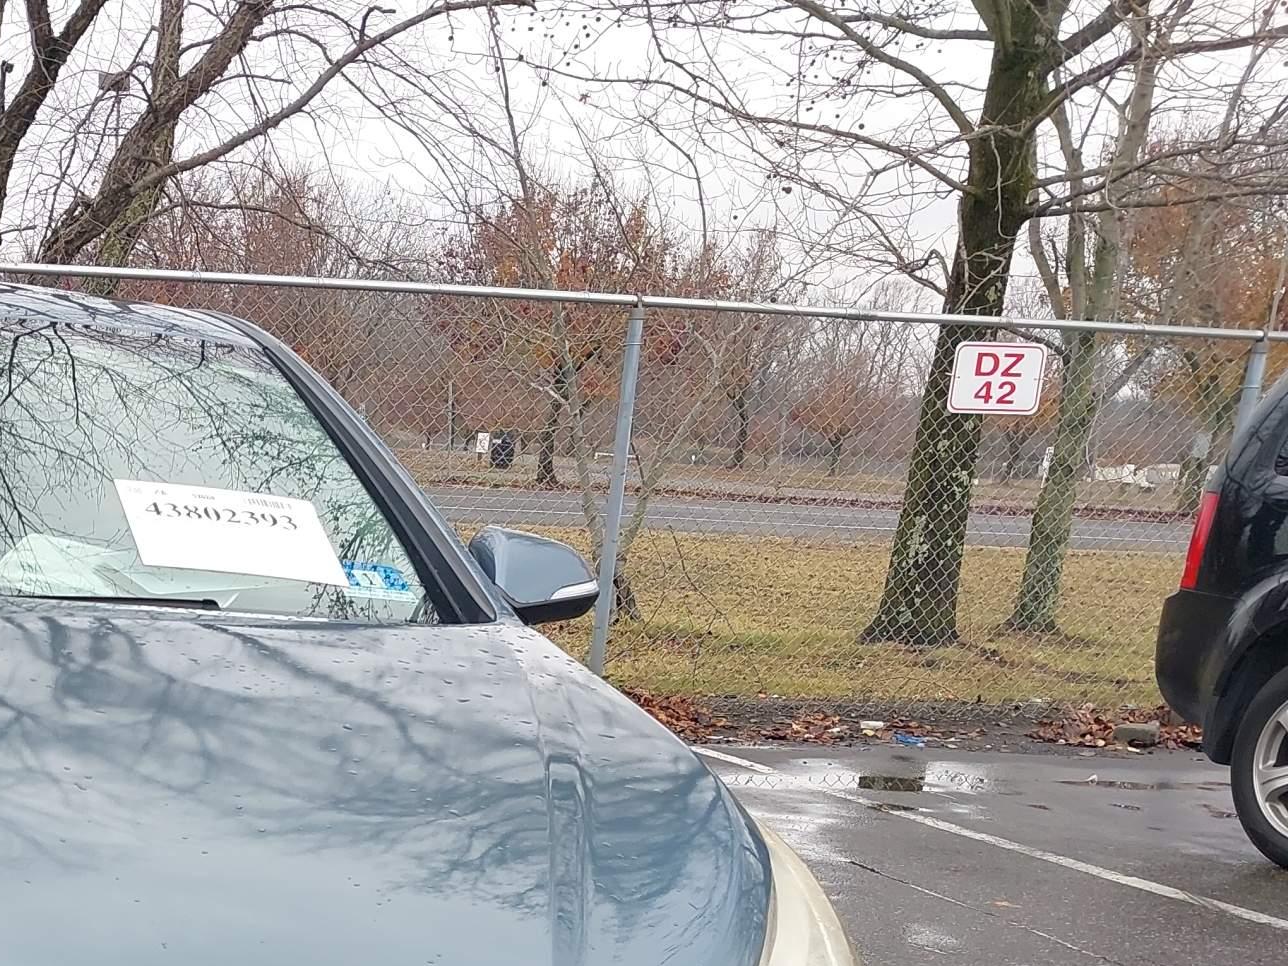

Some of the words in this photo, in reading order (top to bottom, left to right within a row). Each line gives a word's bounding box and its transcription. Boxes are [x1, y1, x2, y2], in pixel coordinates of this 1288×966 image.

[974, 352, 1025, 378] DZ
[973, 381, 1017, 405] 42
[144, 501, 298, 530] 43802393
